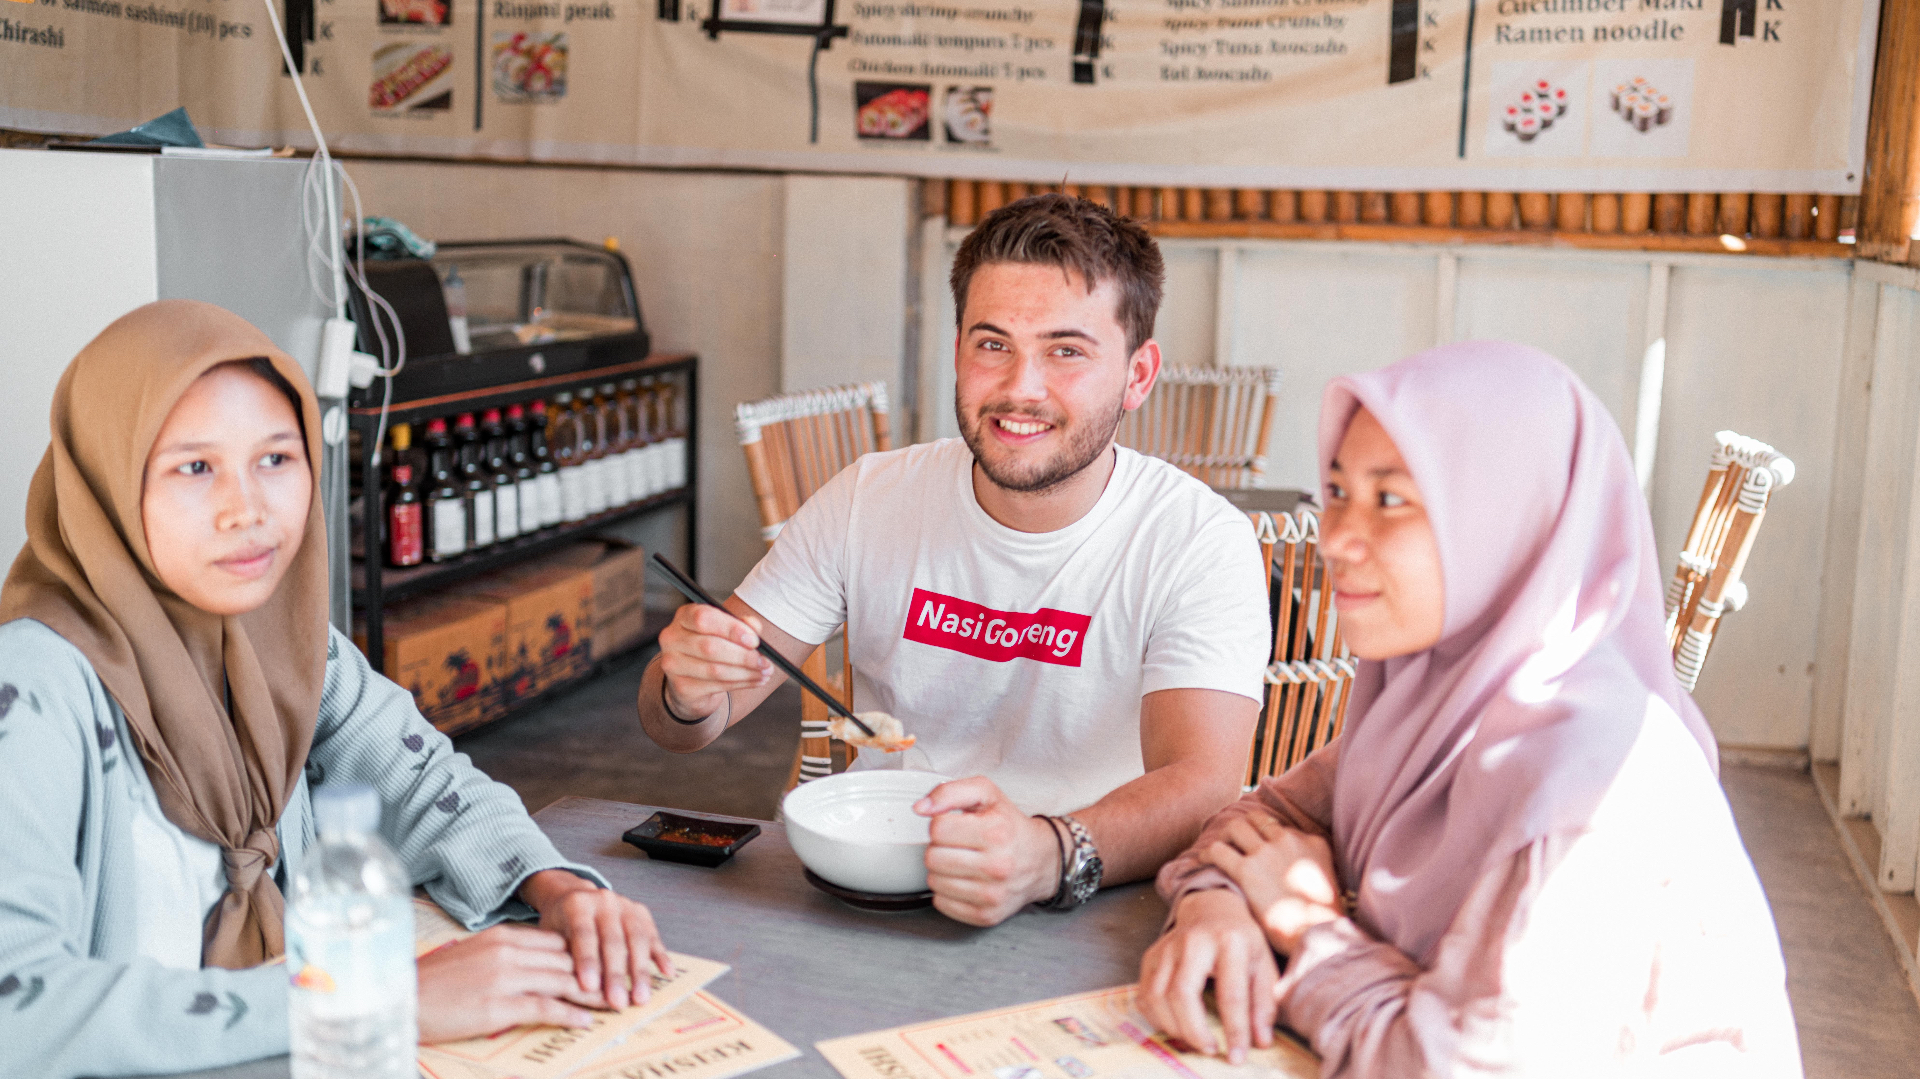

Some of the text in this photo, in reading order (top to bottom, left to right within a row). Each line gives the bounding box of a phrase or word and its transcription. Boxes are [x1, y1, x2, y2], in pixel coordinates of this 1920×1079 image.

[1496, 0, 1624, 16] Cucumber
[125, 4, 187, 29] sashimi
[219, 20, 252, 41] pcs
[1495, 18, 1685, 44] Ramen noodle
[1763, 20, 1782, 42] K
[917, 600, 1079, 657] Nasi Goreng
